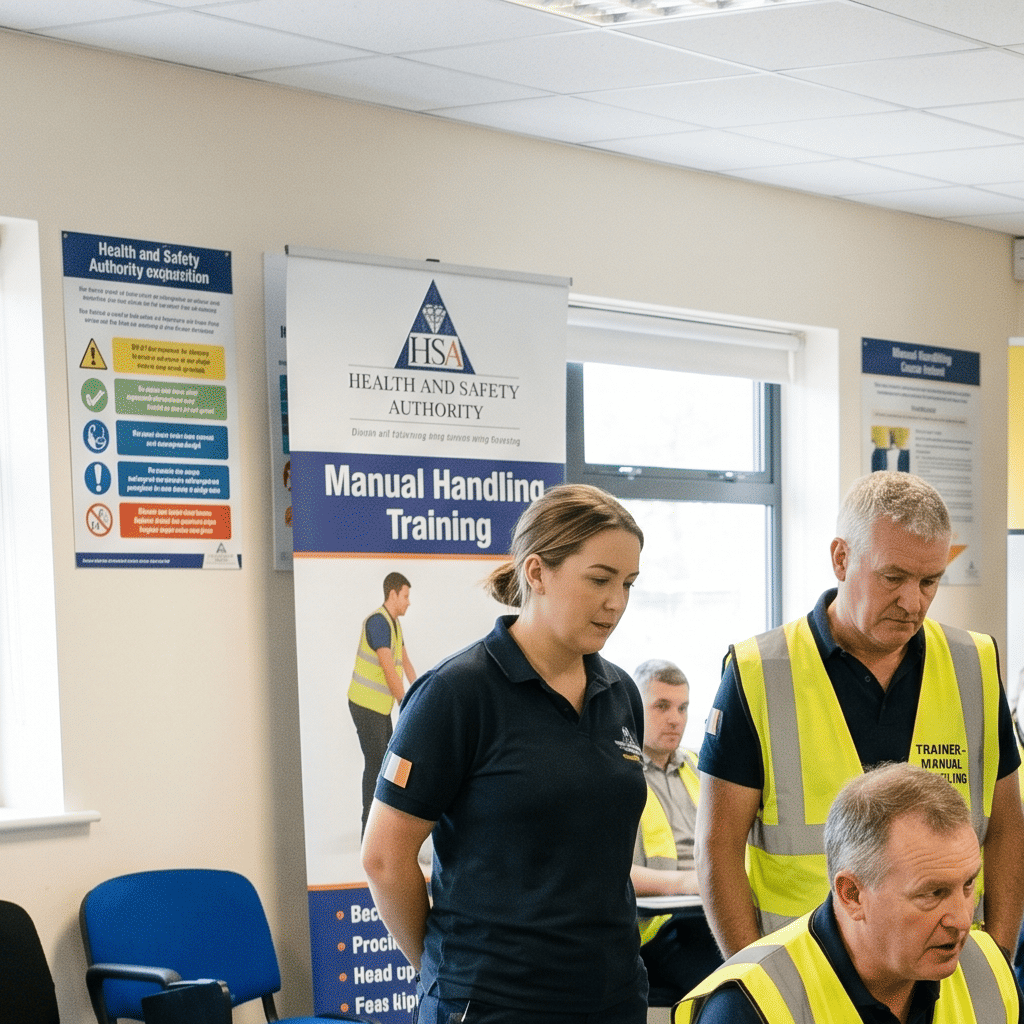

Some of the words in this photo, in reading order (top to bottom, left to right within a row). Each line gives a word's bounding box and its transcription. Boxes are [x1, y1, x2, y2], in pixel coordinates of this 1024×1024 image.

[98, 241, 136, 259] Health
[139, 248, 160, 262] and
[163, 250, 200, 269] Safety
[89, 258, 144, 280] Authority
[410, 336, 463, 367] HSA
[349, 372, 415, 393] HEALTH
[420, 378, 455, 395] AND
[459, 381, 520, 400] SAFETY
[388, 399, 484, 420] AUTHORITY
[325, 464, 425, 499] Manual
[433, 468, 545, 503] Handling
[386, 508, 491, 549] Training
[941, 773, 967, 784] LING
[354, 963, 392, 985] Head
[355, 996, 389, 1015] Feas
